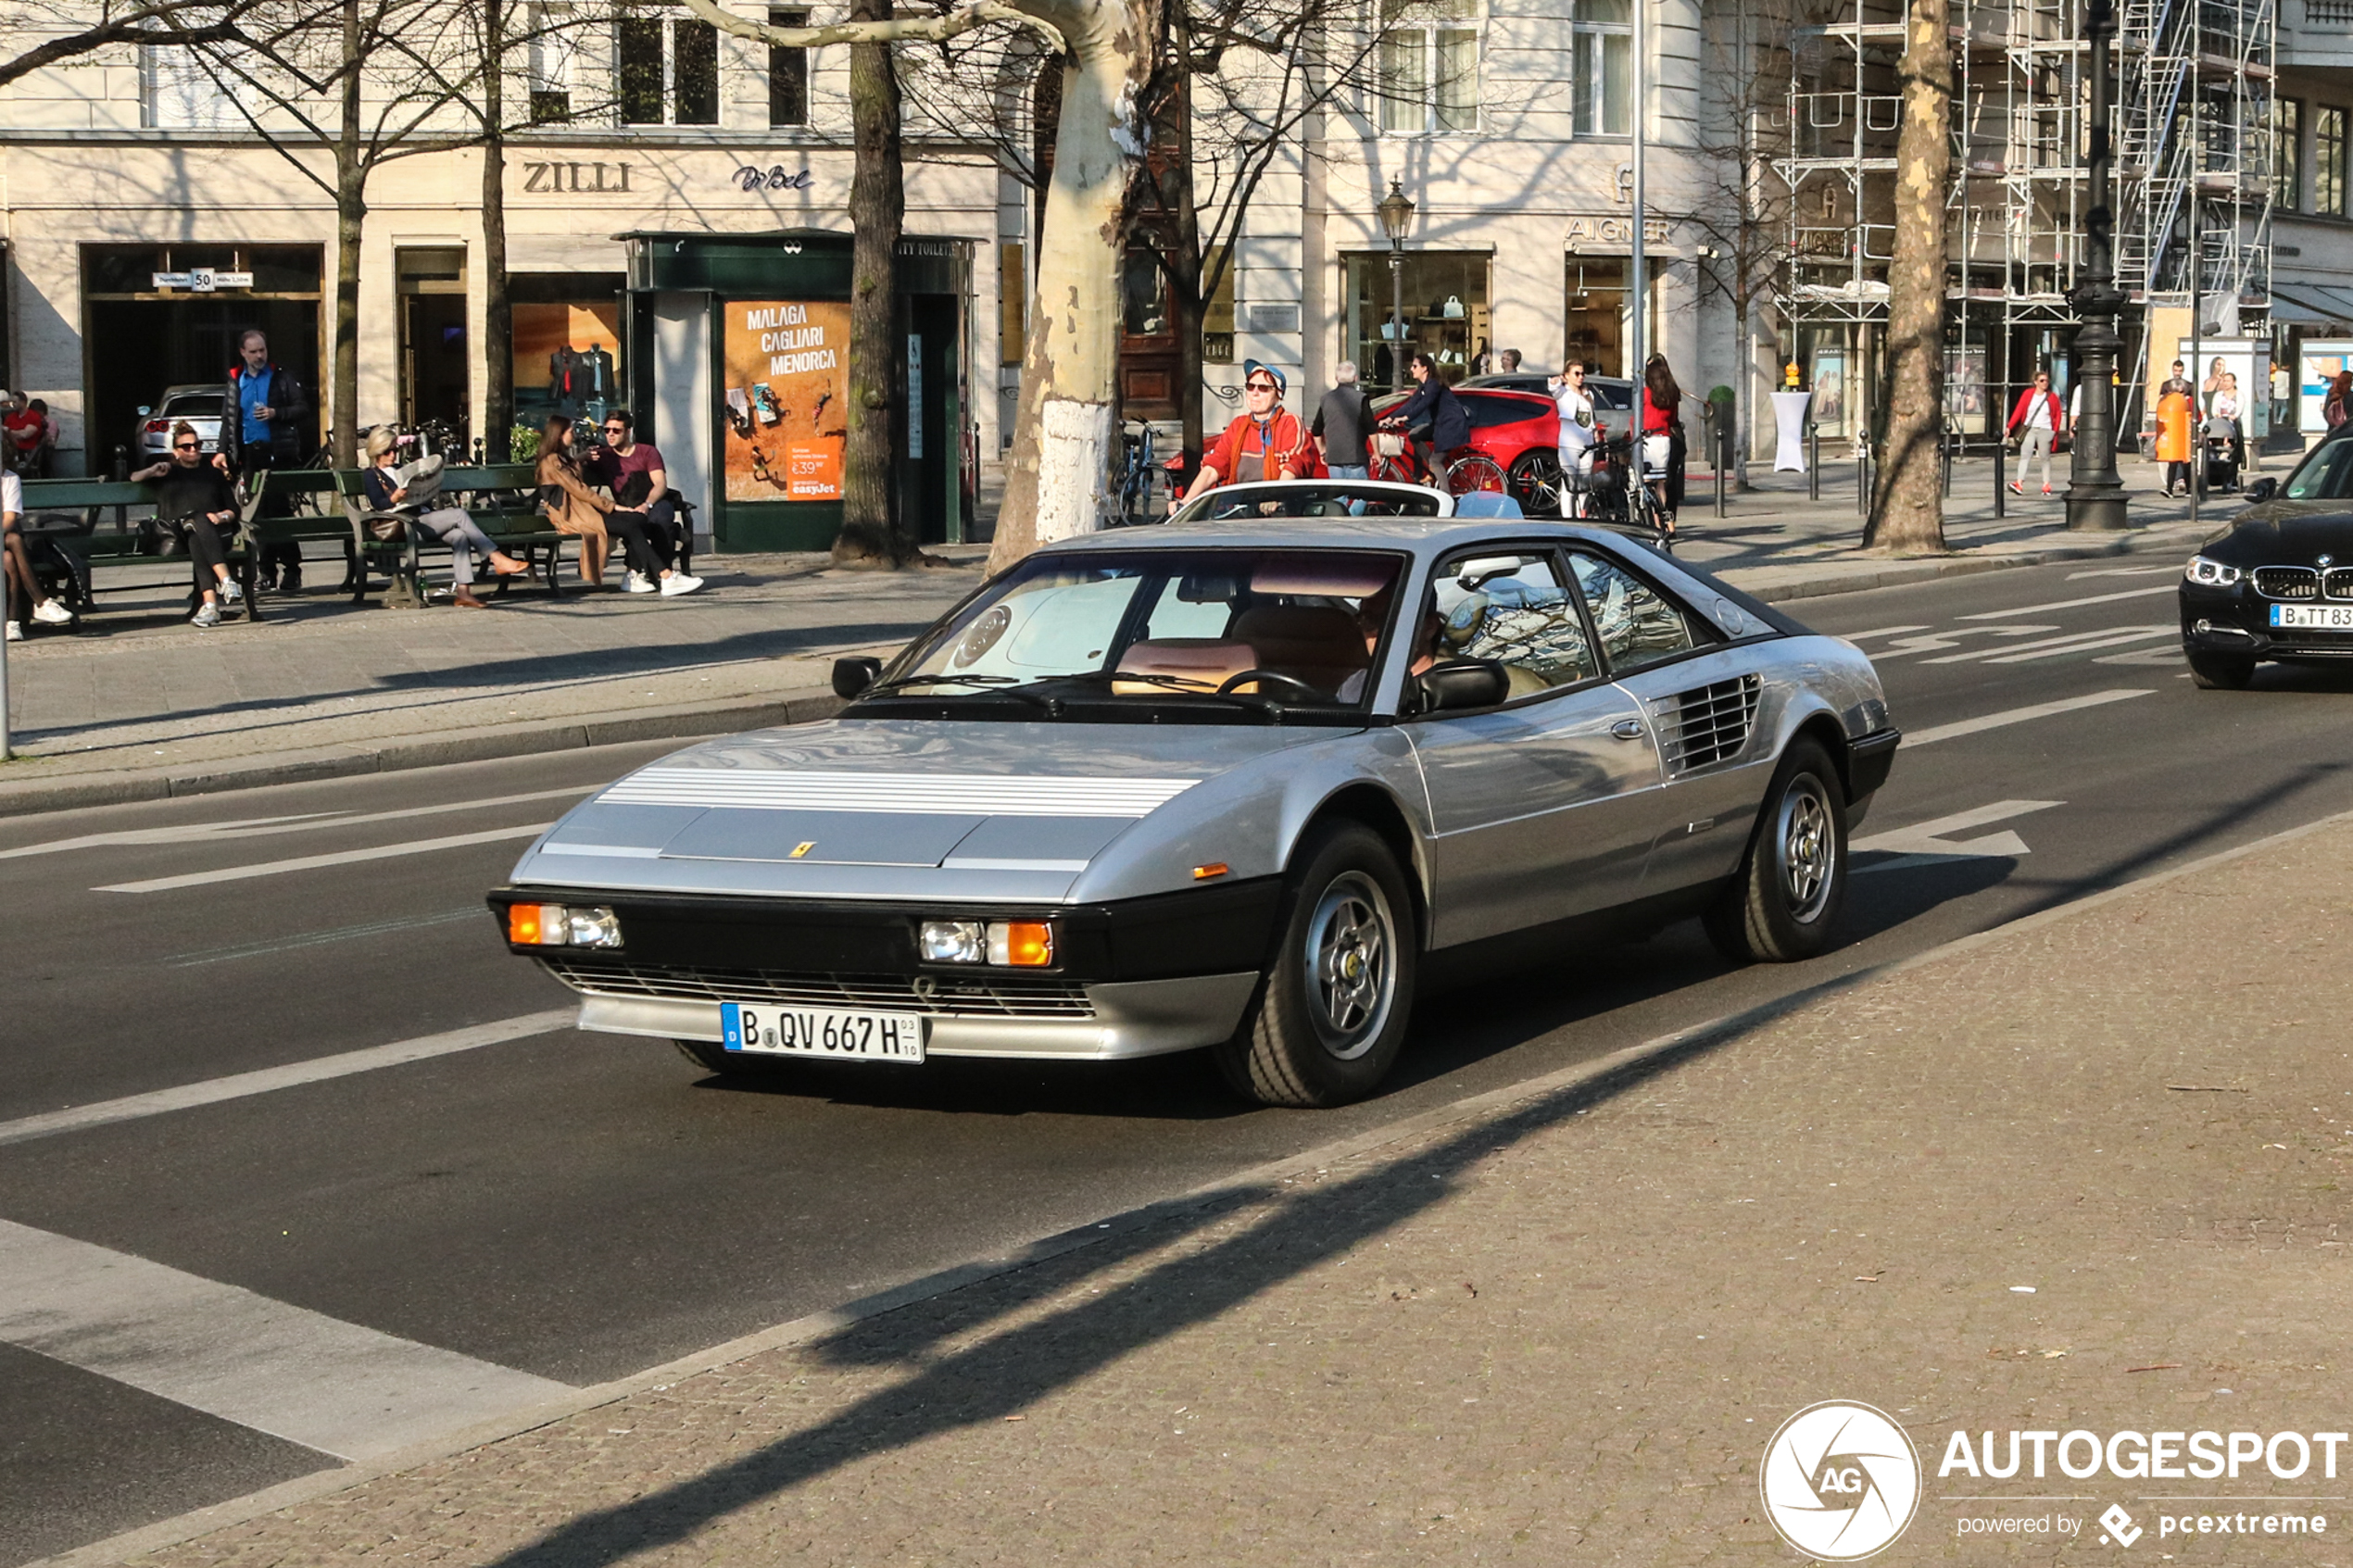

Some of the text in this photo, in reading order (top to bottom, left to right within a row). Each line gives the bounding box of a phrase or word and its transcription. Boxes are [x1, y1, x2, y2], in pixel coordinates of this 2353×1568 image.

[523, 161, 632, 193] ZILLI
[1566, 218, 1671, 241] AIGNER
[195, 274, 210, 285] 50
[748, 305, 807, 331] MALAGA
[761, 326, 824, 353] CAGLIARI
[771, 349, 837, 376] MENORCA
[792, 483, 836, 495] easyJet
[2285, 608, 2296, 624] B
[2307, 608, 2328, 625] TT
[2331, 609, 2352, 625] 83
[729, 1010, 900, 1054] D B QV 667 H
[901, 1020, 914, 1030] 03
[904, 1045, 917, 1056] 10
